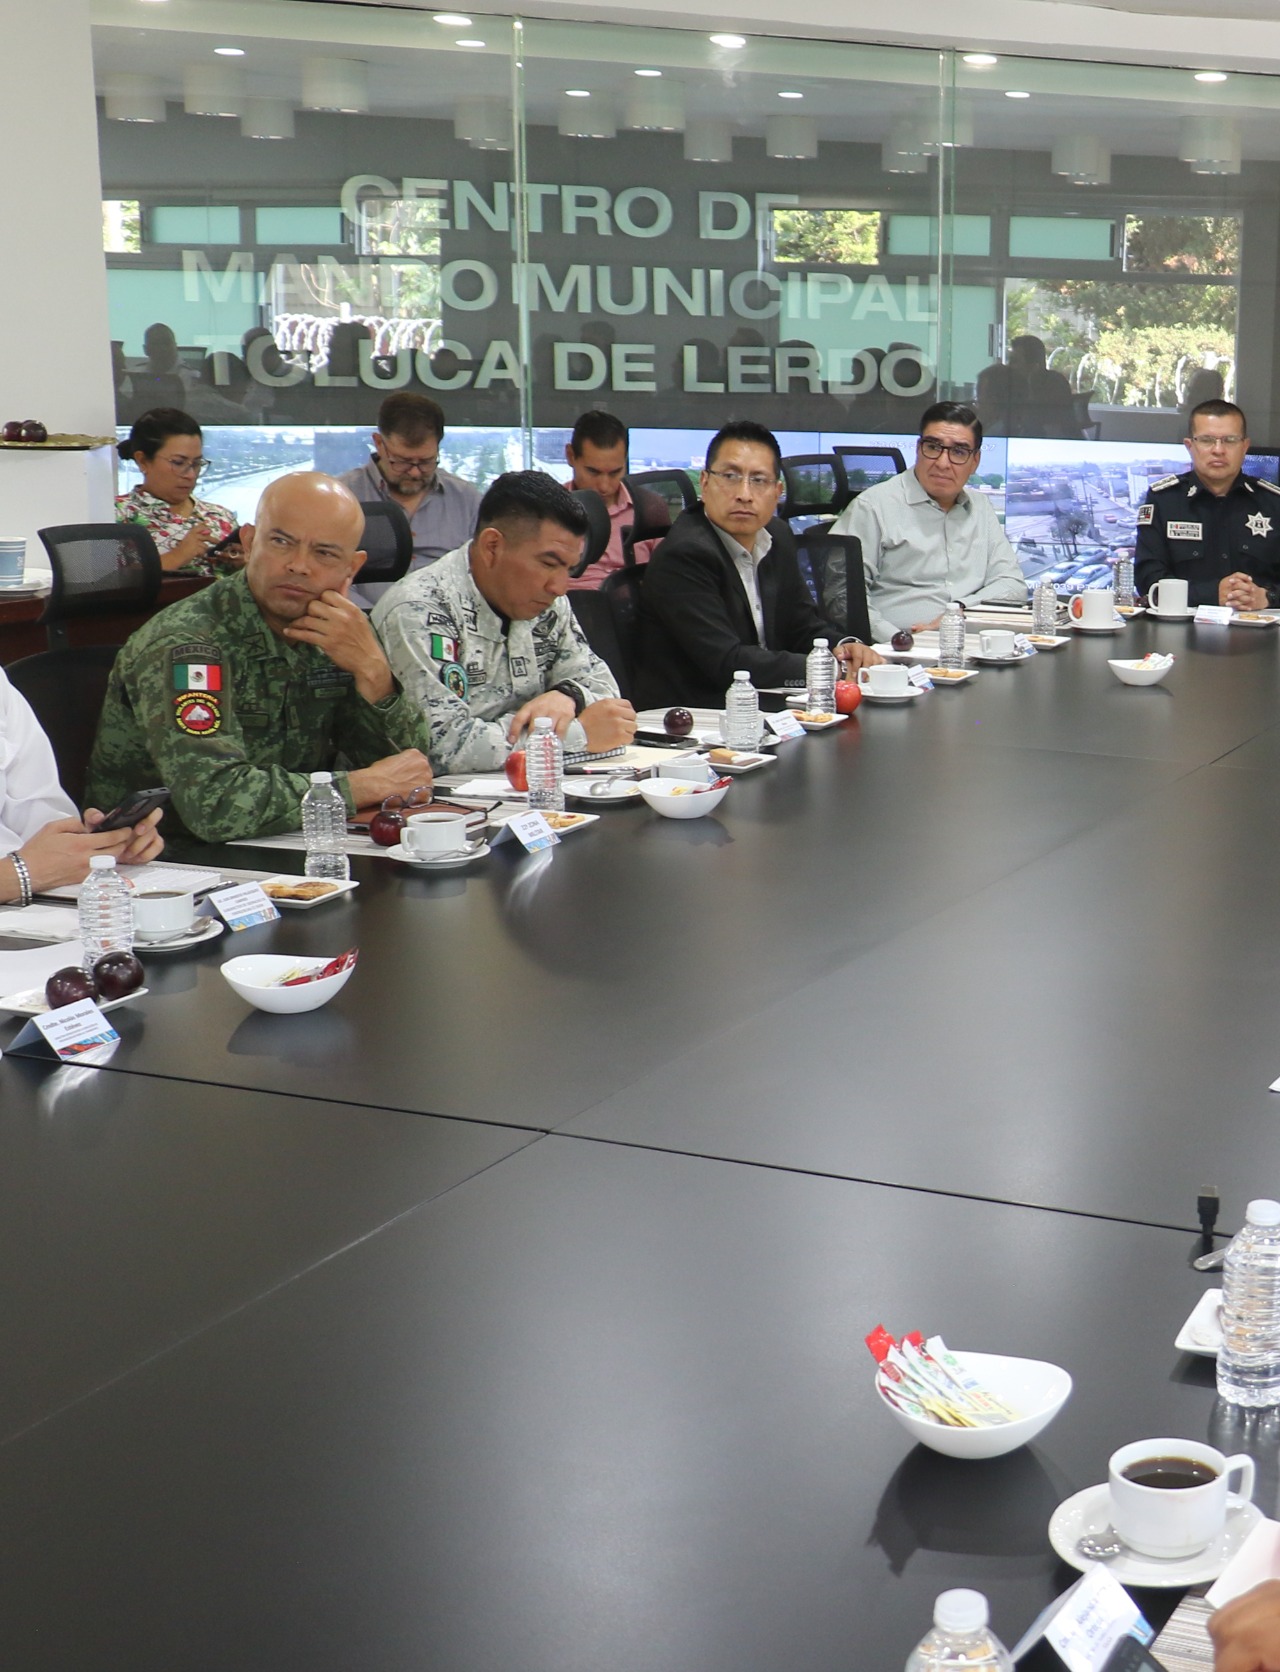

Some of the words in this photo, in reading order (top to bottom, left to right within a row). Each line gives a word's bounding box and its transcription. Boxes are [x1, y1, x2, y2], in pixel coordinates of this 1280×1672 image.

[340, 174, 673, 238] CENTRO
[181, 250, 498, 311] MANDO
[512, 262, 938, 322] MUNICIPAL
[194, 335, 522, 390] TOLUCA
[553, 342, 657, 392] DE
[683, 345, 936, 396] LERDO
[174, 645, 219, 657] MEXICO
